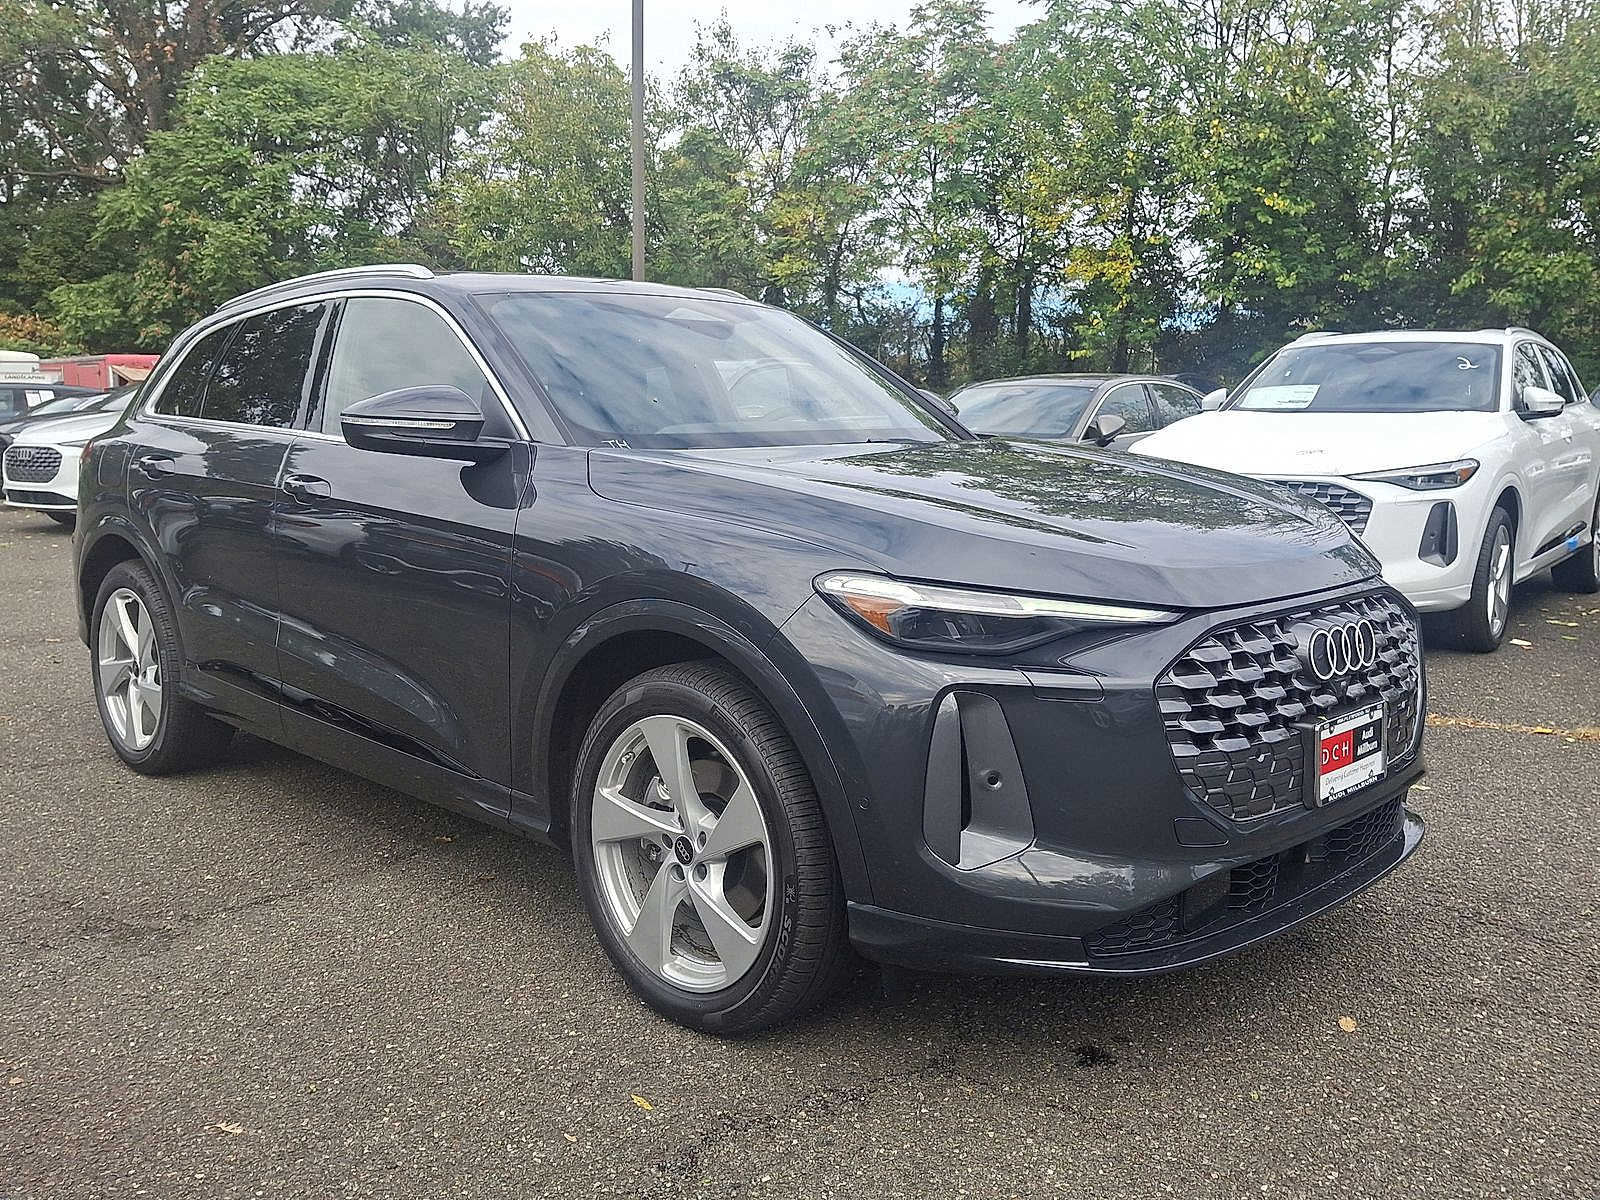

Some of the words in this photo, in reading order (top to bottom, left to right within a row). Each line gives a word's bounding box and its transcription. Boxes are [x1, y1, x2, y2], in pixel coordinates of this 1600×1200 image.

[1456, 356, 1480, 370] 2
[601, 439, 632, 450] TH
[1361, 726, 1374, 740] Audi
[1356, 740, 1378, 756] Millburn
[1328, 788, 1346, 802] AUDI
[1347, 775, 1378, 794] MILLBURN
